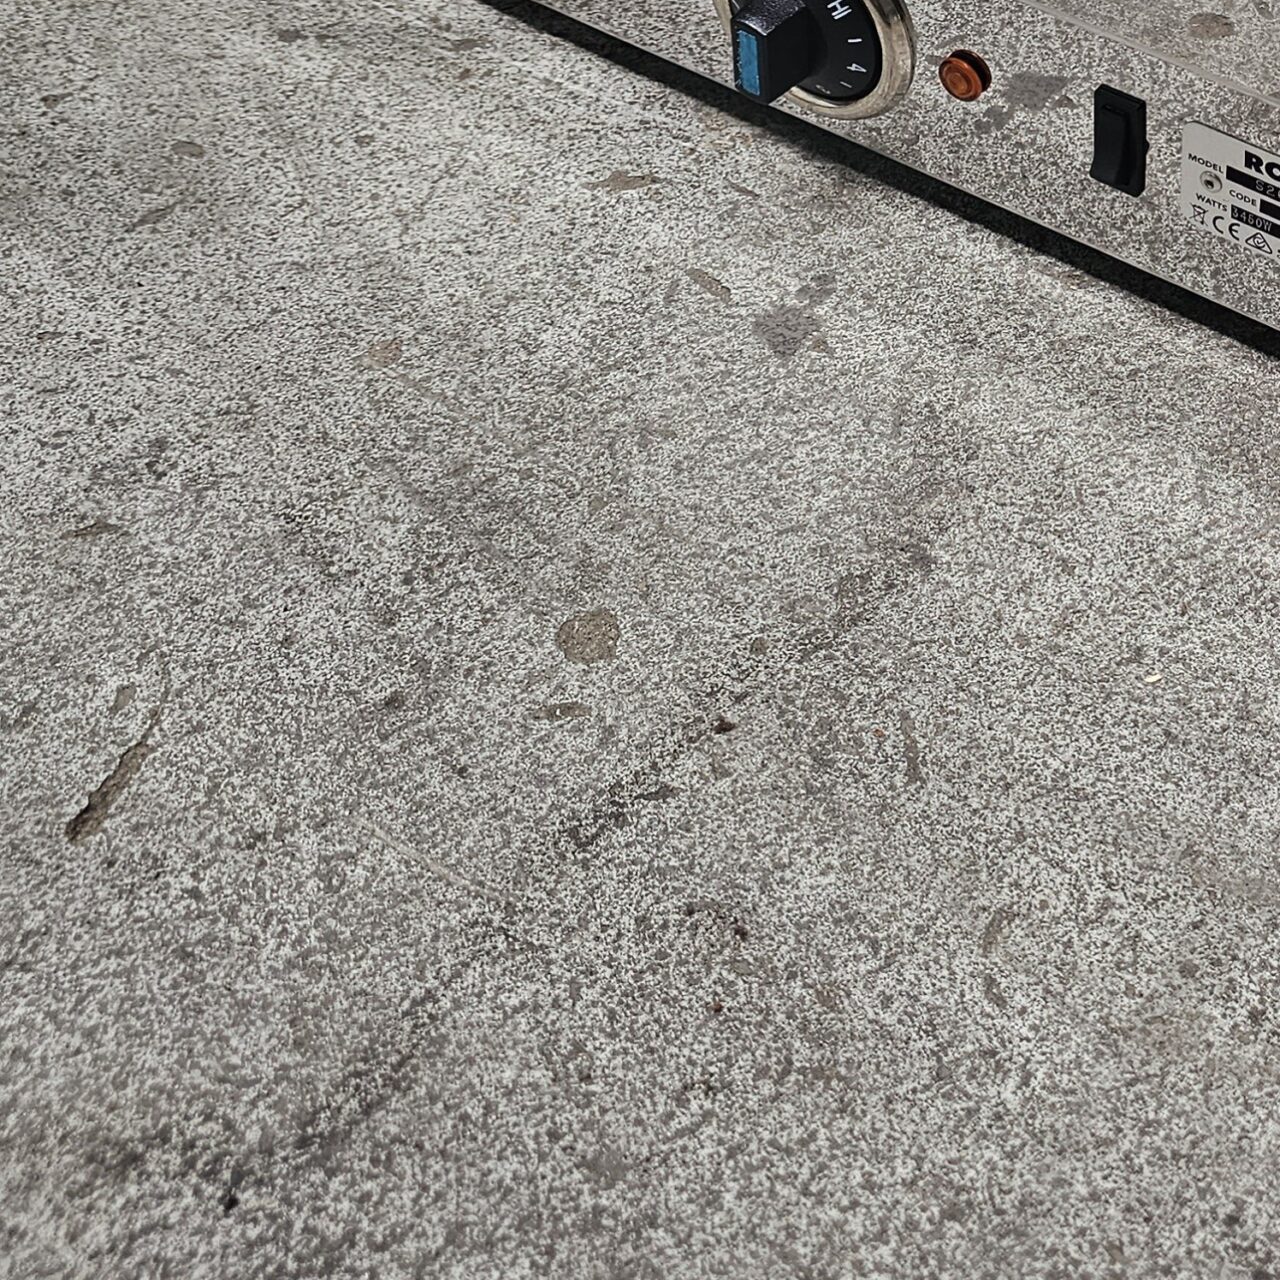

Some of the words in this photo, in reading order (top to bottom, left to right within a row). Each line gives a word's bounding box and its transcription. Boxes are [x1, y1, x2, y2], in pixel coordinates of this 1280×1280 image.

[1188, 153, 1224, 174] MODEL
[1195, 193, 1228, 212] WATTS
[1229, 189, 1257, 207] CODE
